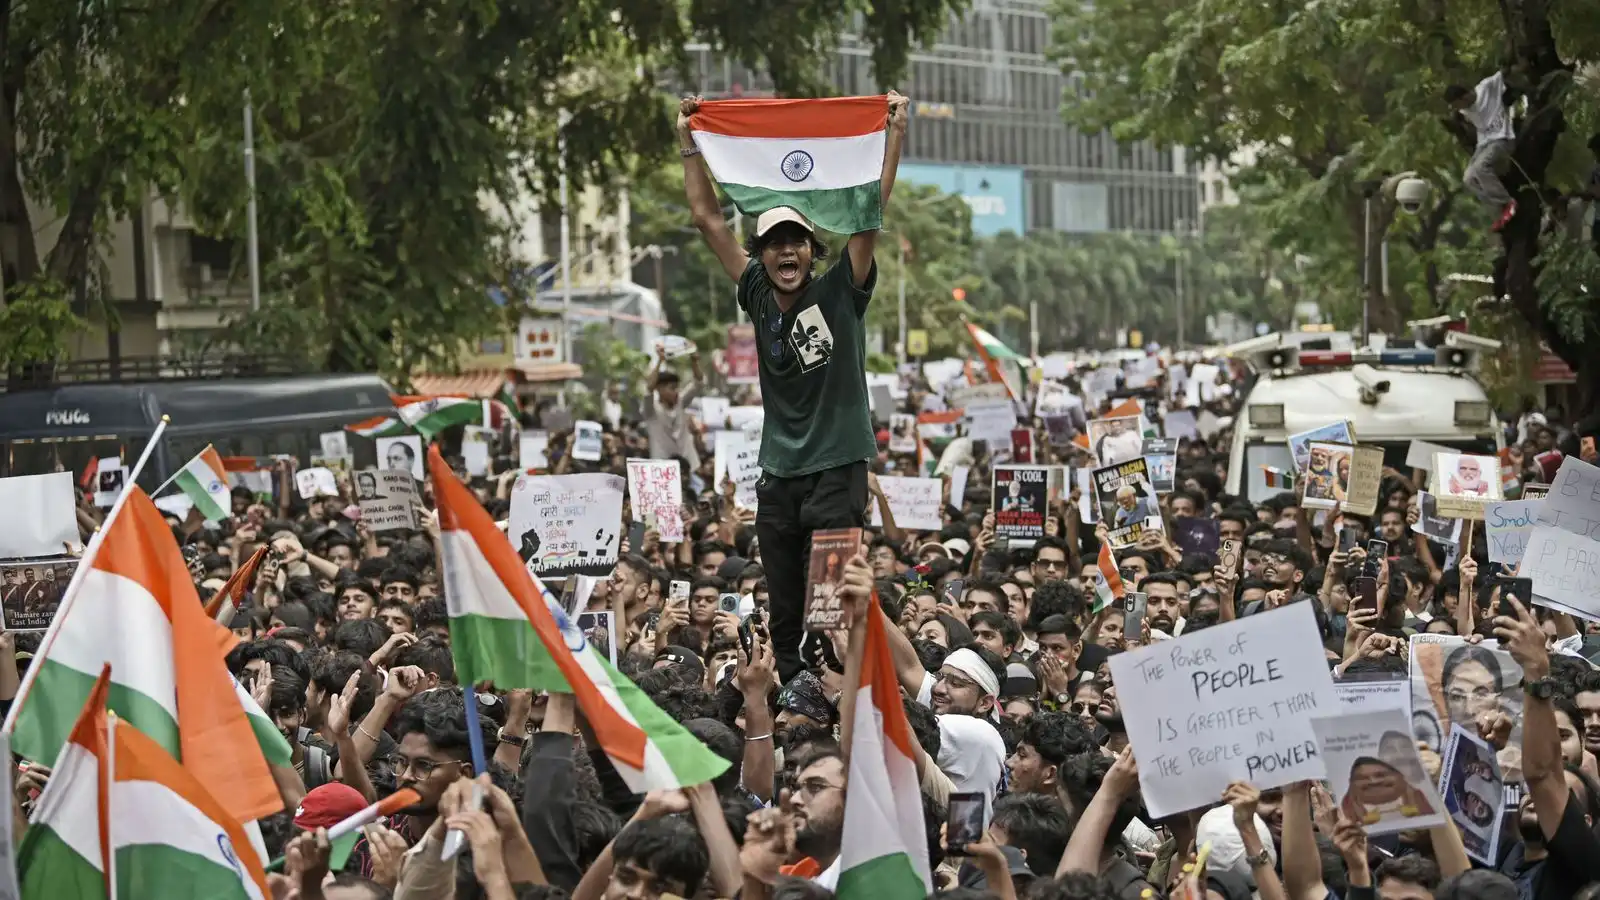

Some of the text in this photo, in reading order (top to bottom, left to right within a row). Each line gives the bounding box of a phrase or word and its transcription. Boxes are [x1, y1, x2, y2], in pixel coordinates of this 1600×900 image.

[1022, 470, 1044, 482] COOL
[27, 617, 46, 625] India
[1191, 658, 1284, 700] PEOPLE
[1156, 691, 1319, 743] IS GREATER THAN
[1151, 728, 1275, 778] THE PEOPLE IN
[1246, 739, 1318, 781] POWER
